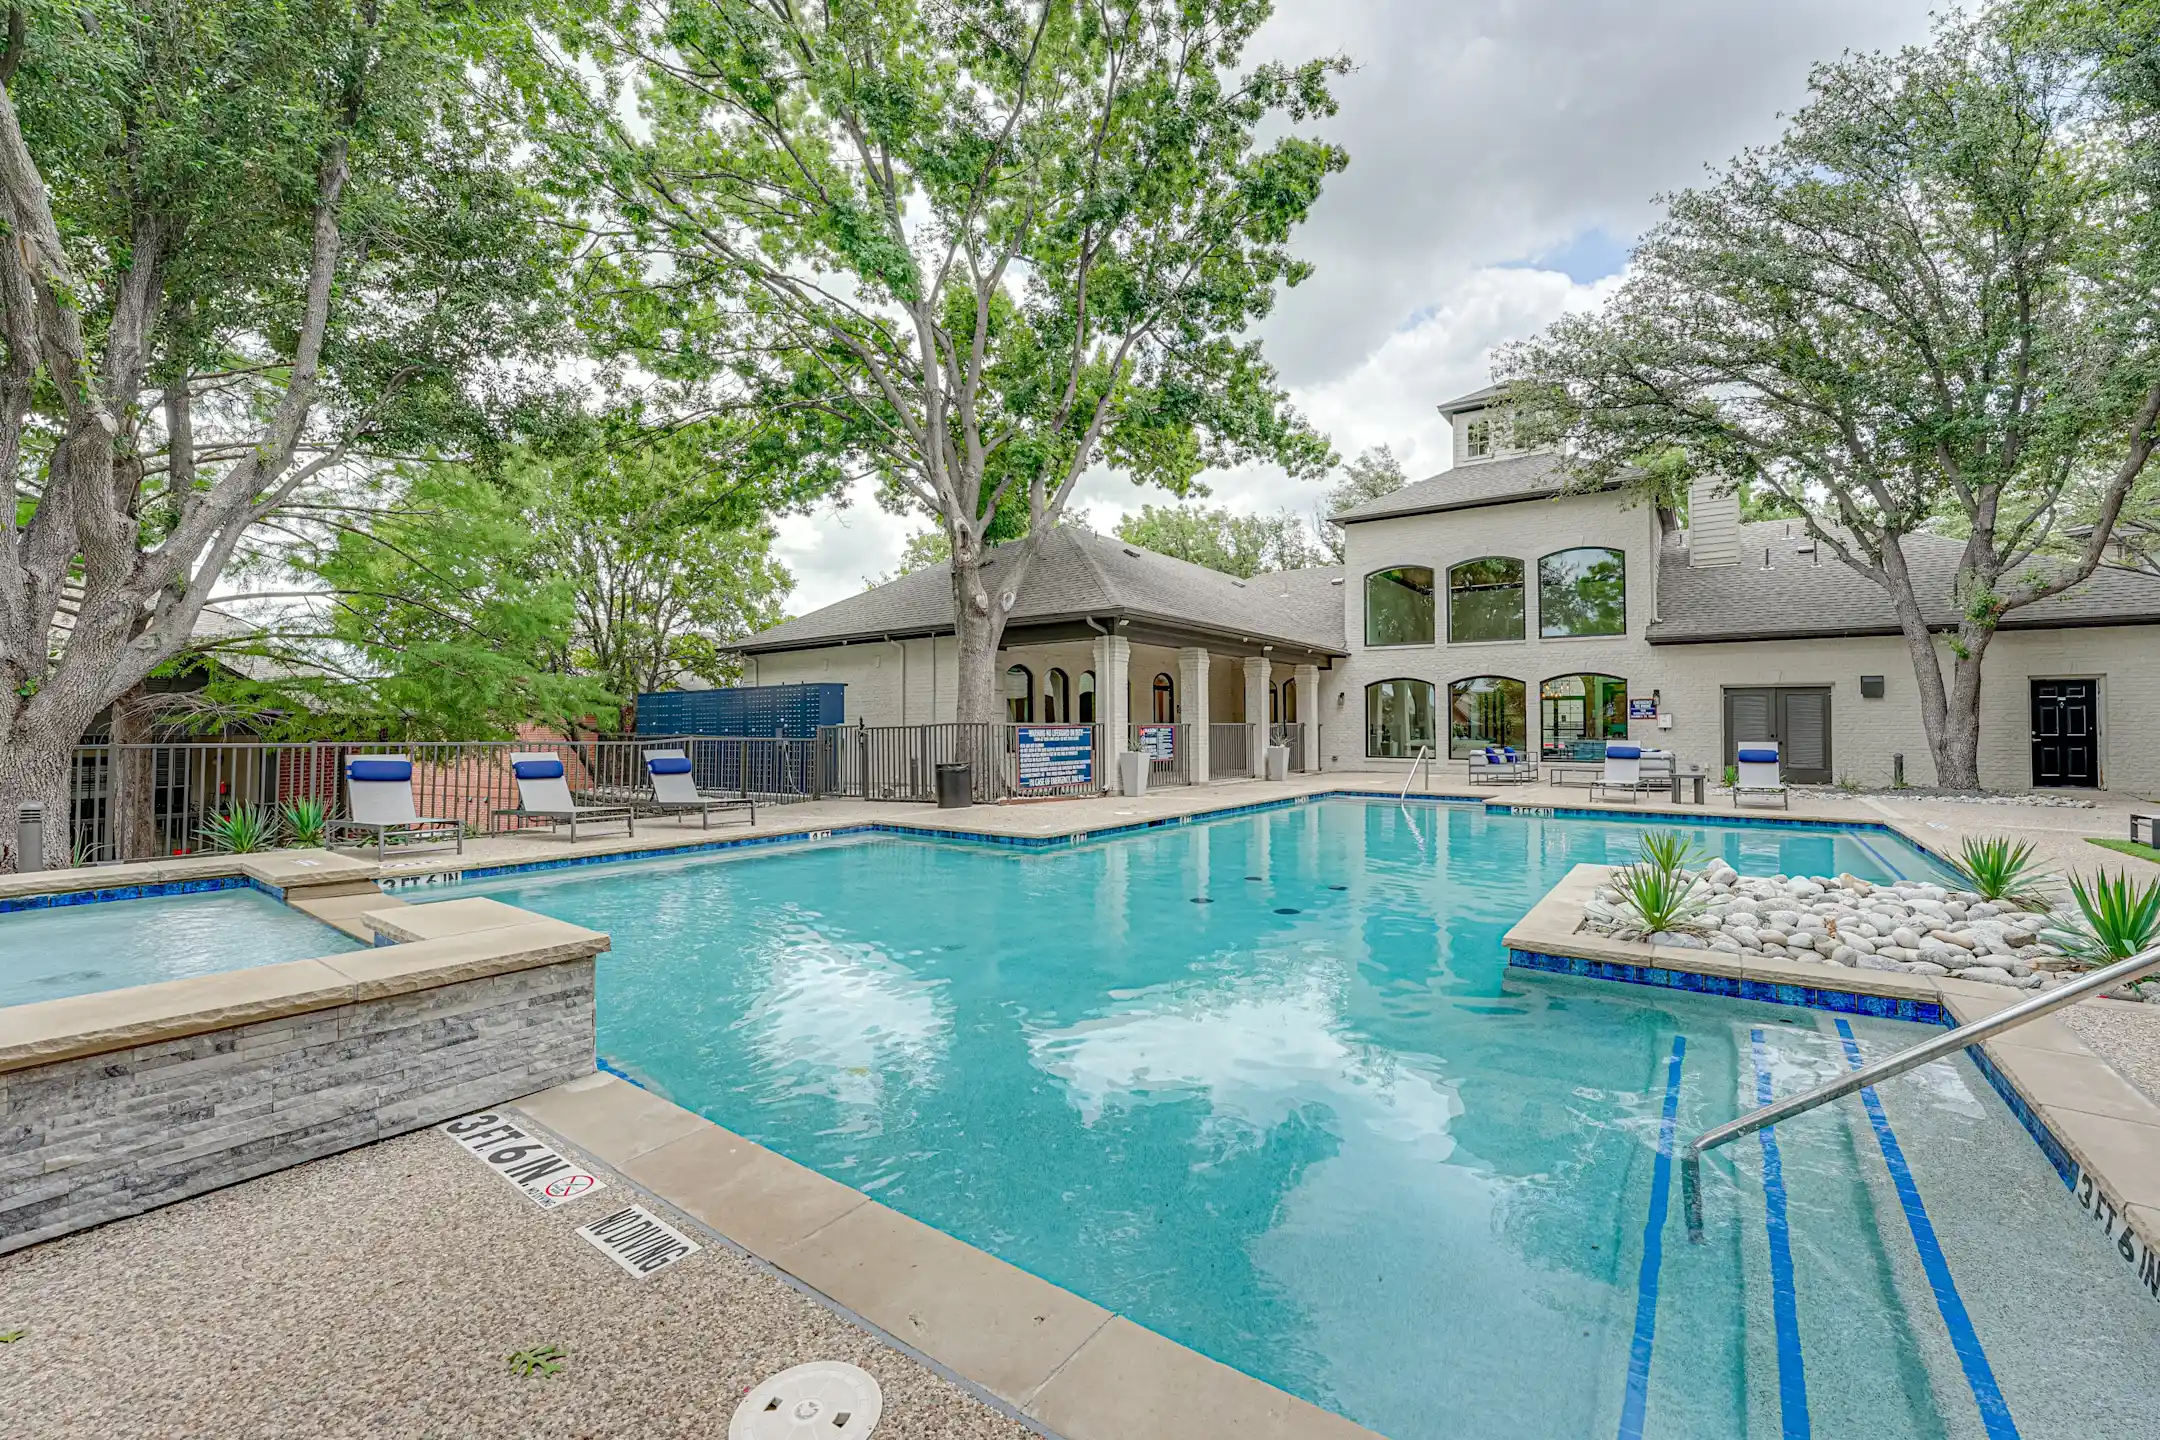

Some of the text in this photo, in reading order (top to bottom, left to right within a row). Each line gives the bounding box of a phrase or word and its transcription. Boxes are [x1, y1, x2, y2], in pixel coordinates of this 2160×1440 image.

[1035, 778, 1045, 786] CASE
[1045, 777, 1051, 786] OF
[488, 1144, 544, 1164] 6
[2077, 1173, 2093, 1210] 3
[2117, 1226, 2135, 1263] 6
[585, 1207, 689, 1273] NO DIVING
